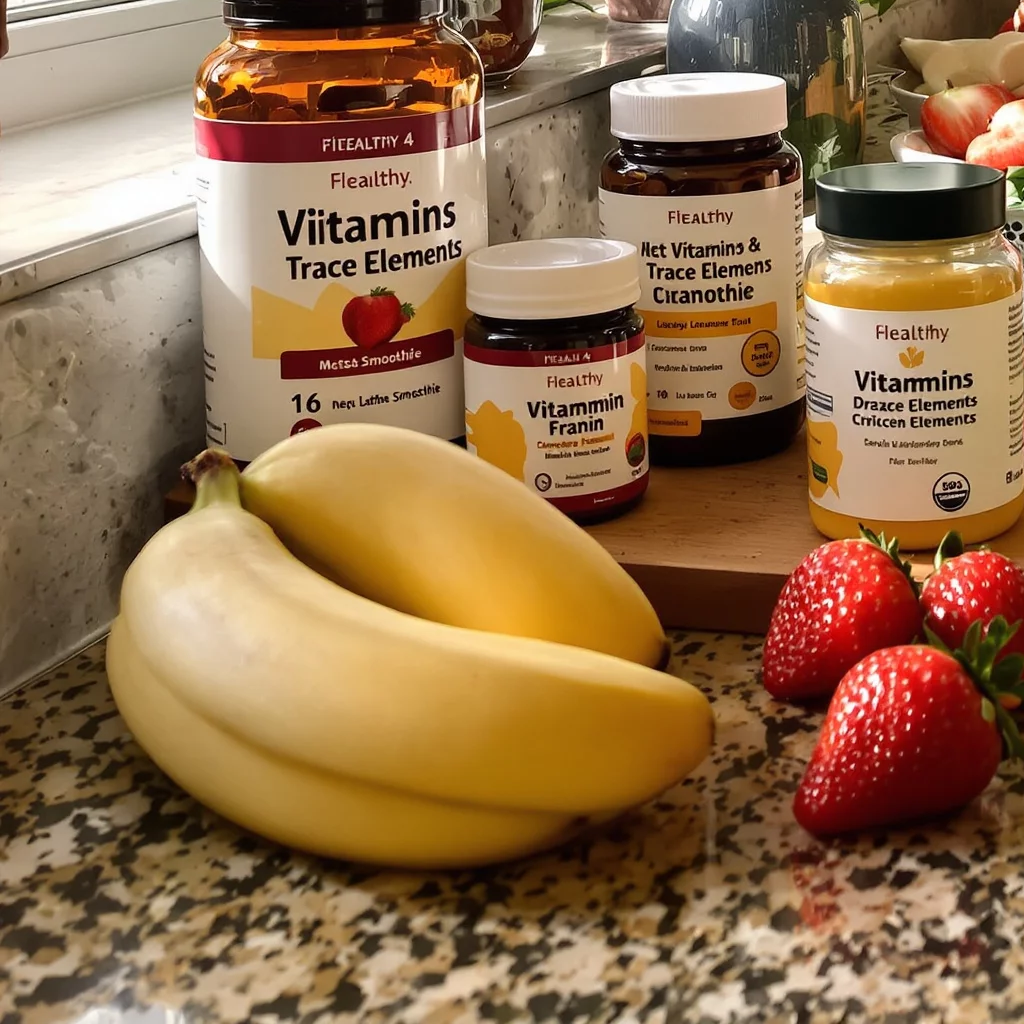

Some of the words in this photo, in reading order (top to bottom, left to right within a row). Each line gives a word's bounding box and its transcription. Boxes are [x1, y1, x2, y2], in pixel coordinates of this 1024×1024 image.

[403, 131, 415, 147] 4
[748, 236, 761, 253] &
[286, 256, 357, 280] Trace
[365, 238, 463, 275] Elements
[646, 262, 696, 280] Trace
[701, 258, 772, 280] Elemens
[361, 347, 422, 367] Smoothie
[291, 392, 322, 414] 16
[909, 395, 978, 413] Elements
[549, 416, 604, 437] Franin
[910, 413, 977, 429] Elements
